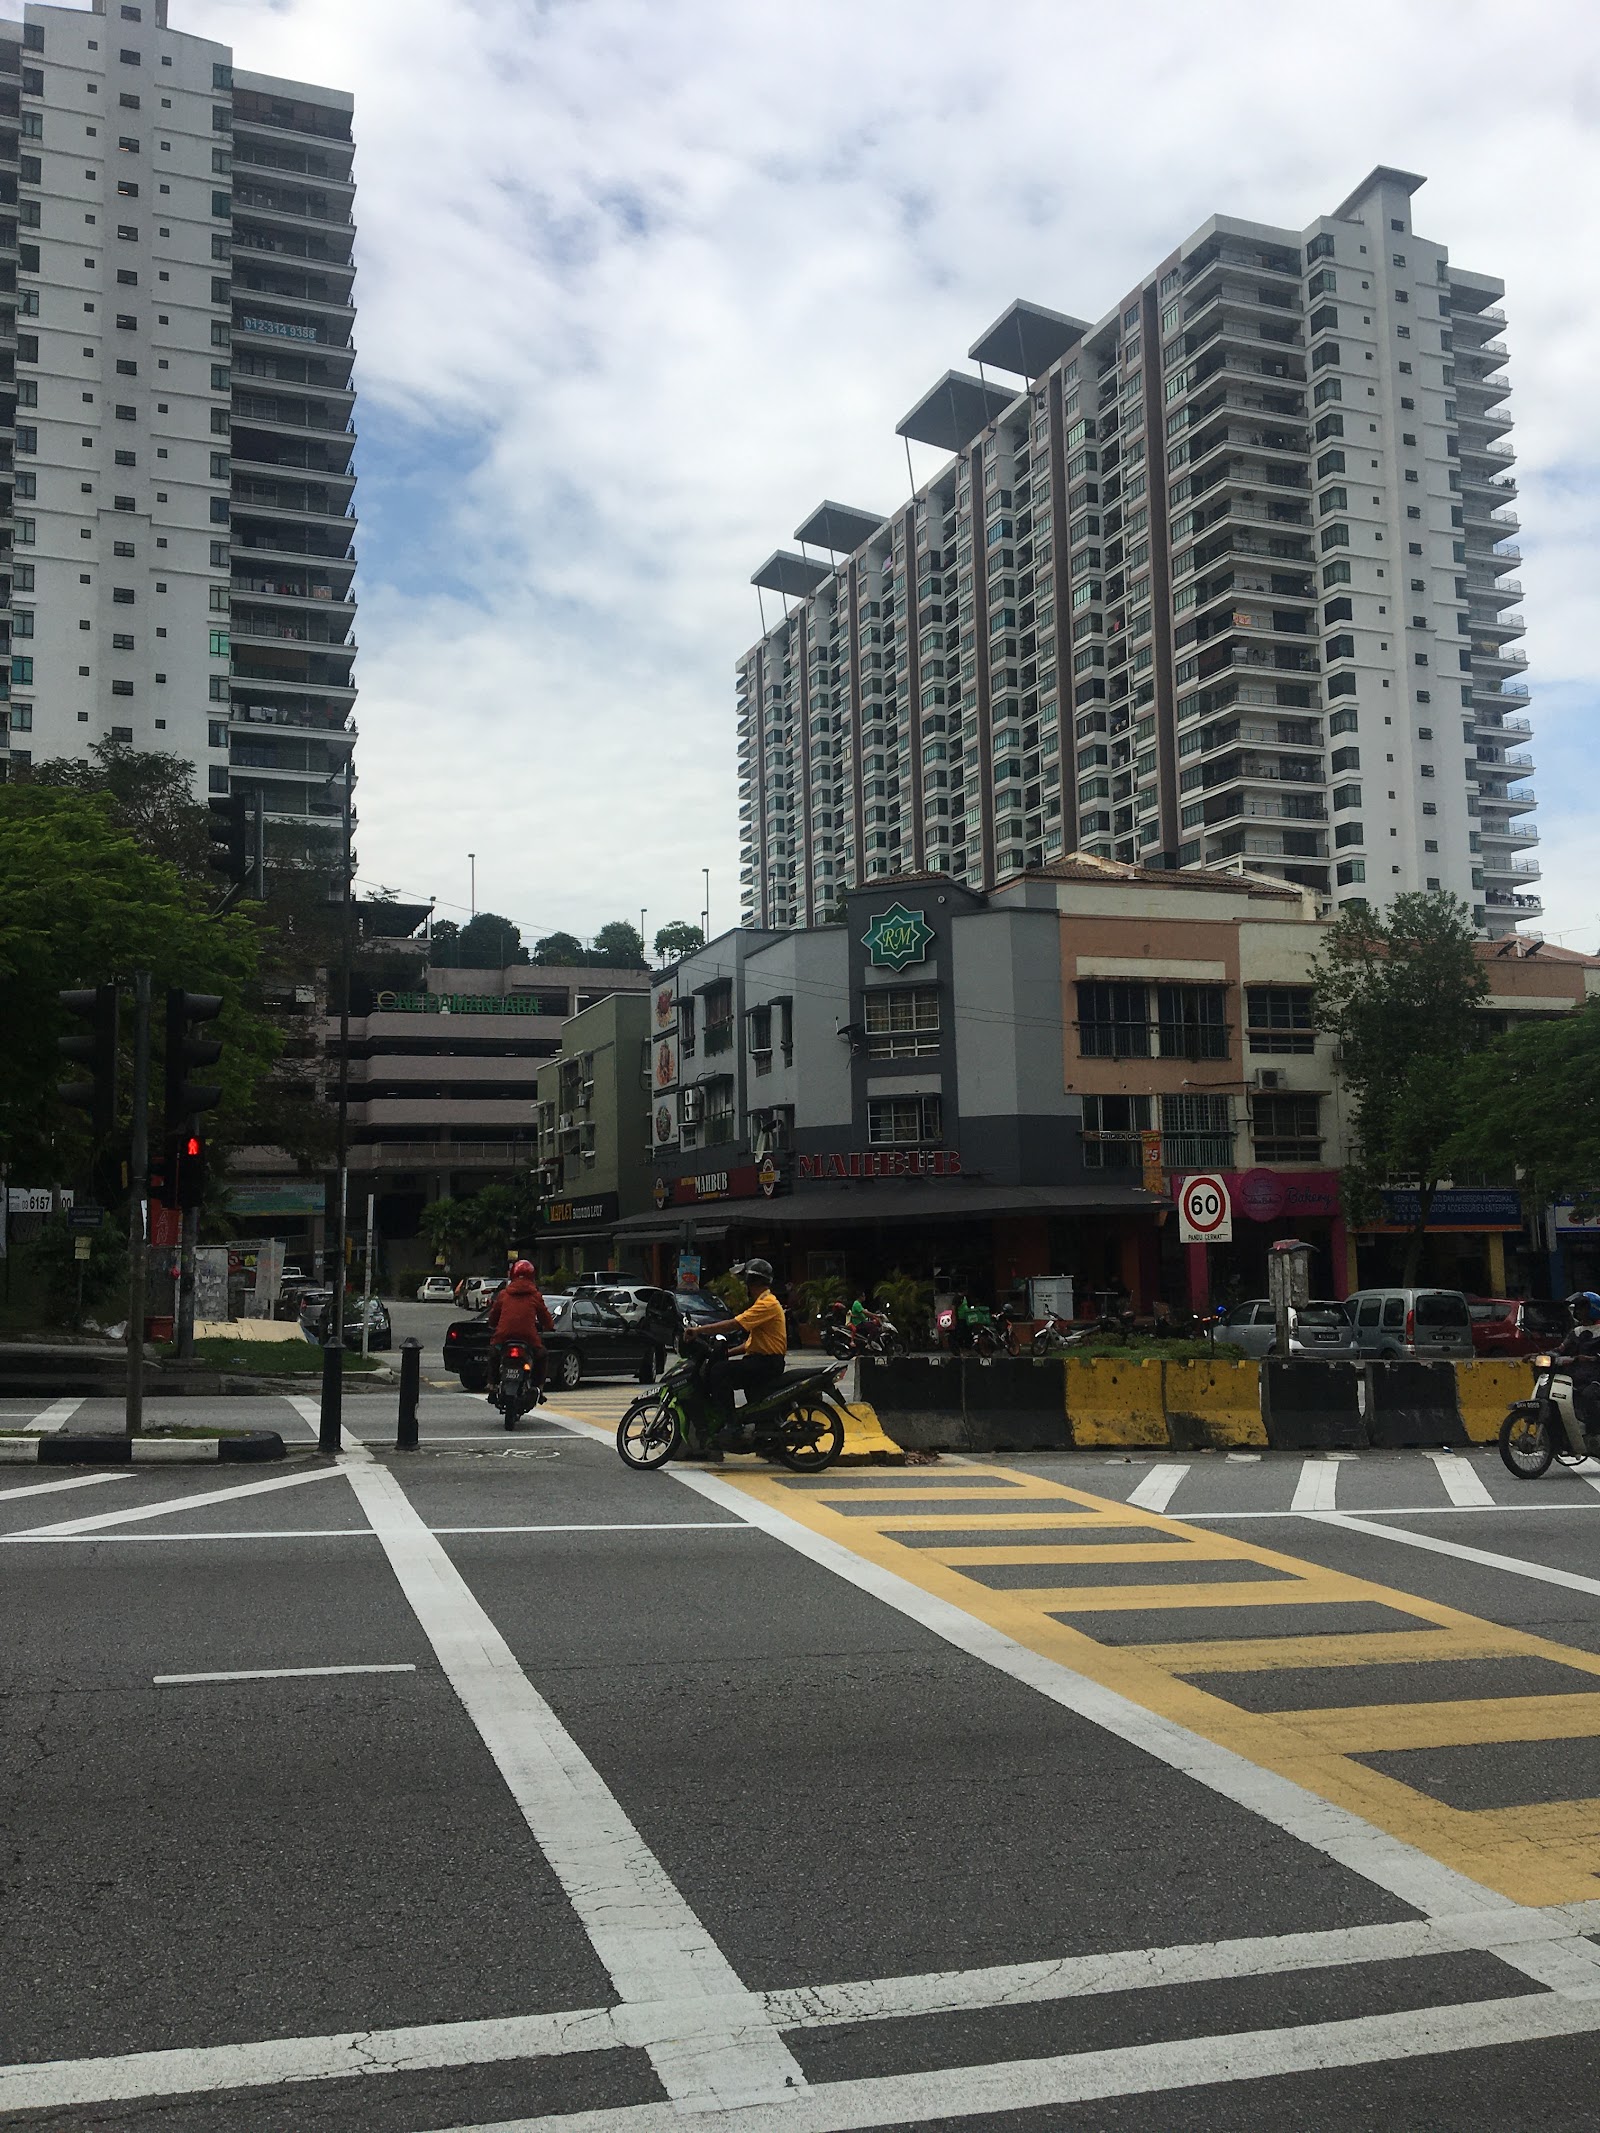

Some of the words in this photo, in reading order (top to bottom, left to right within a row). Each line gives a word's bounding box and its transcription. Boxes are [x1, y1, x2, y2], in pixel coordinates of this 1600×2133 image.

[245, 318, 287, 335] 012-314
[882, 927, 911, 950] RM
[377, 991, 423, 1012] ONE
[425, 992, 539, 1014] DAMANSARA
[798, 1150, 962, 1178] MAHBUB
[695, 1172, 728, 1194] MAHBUB
[29, 1196, 50, 1210] 6157
[1191, 1194, 1219, 1216] 60
[1286, 1186, 1332, 1209] Bakery
